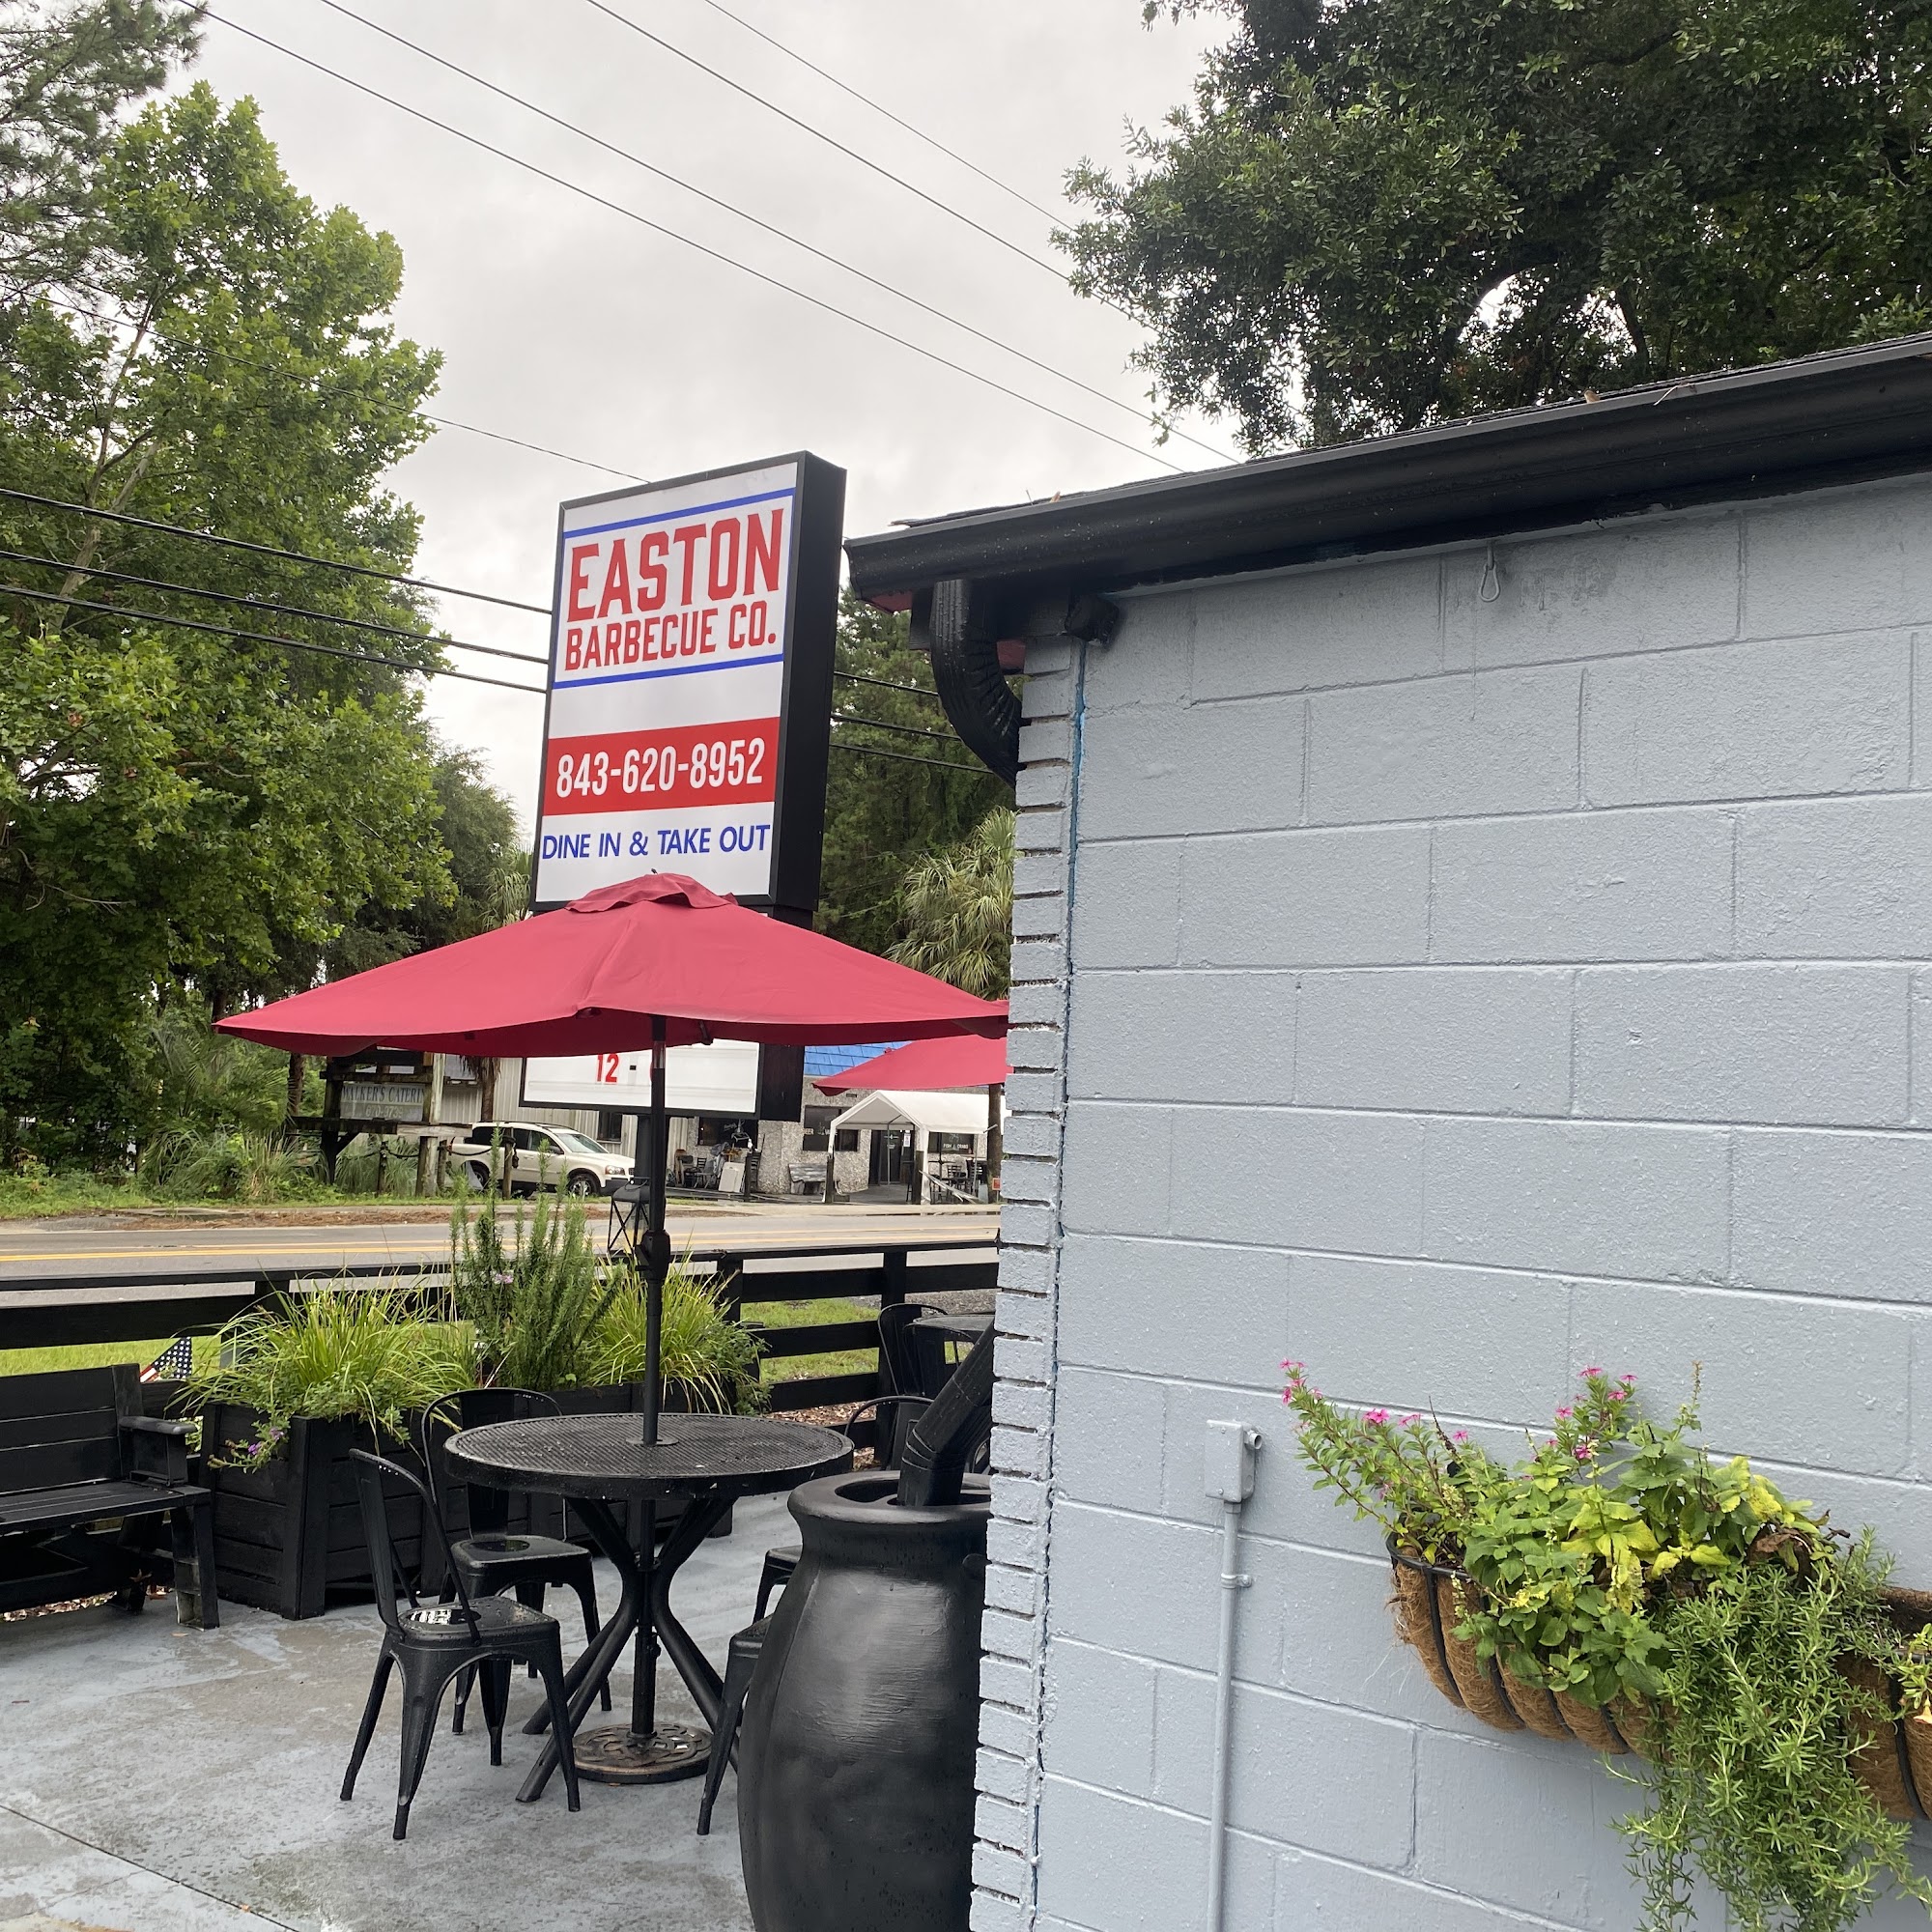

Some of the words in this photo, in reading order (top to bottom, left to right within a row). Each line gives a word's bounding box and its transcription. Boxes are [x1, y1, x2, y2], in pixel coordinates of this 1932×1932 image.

[567, 508, 783, 622] EASTON
[565, 607, 719, 670] BARBECUE
[728, 600, 777, 649] CO.
[556, 737, 765, 798] 843-620-8952
[542, 834, 591, 859] DINE
[598, 832, 621, 857] IN
[629, 831, 649, 856] &
[657, 828, 711, 854] TAKE
[719, 824, 771, 852] OUT
[596, 1052, 620, 1083] 12
[342, 1085, 386, 1102] WALKER'S
